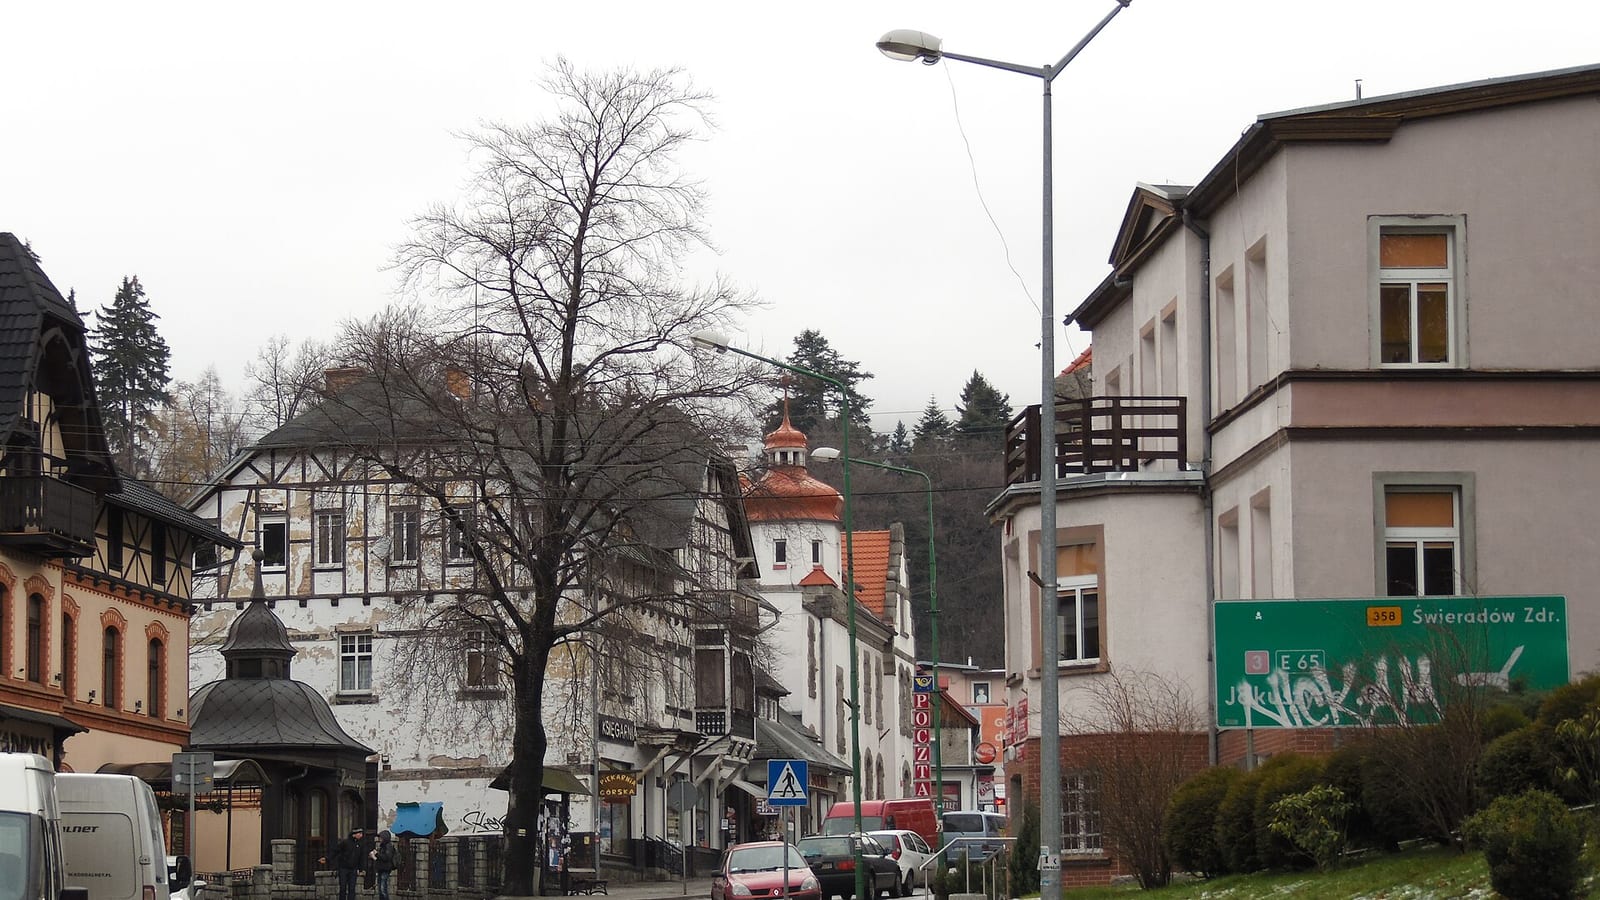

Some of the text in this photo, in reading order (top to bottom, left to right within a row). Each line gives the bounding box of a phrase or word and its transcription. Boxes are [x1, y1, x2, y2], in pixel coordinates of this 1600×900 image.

[1373, 611, 1396, 622] 358
[1412, 604, 1560, 624] Świeradów Zdr.
[1252, 654, 1263, 670] 3
[1281, 654, 1320, 670] E 65
[915, 694, 929, 796] POCZTA
